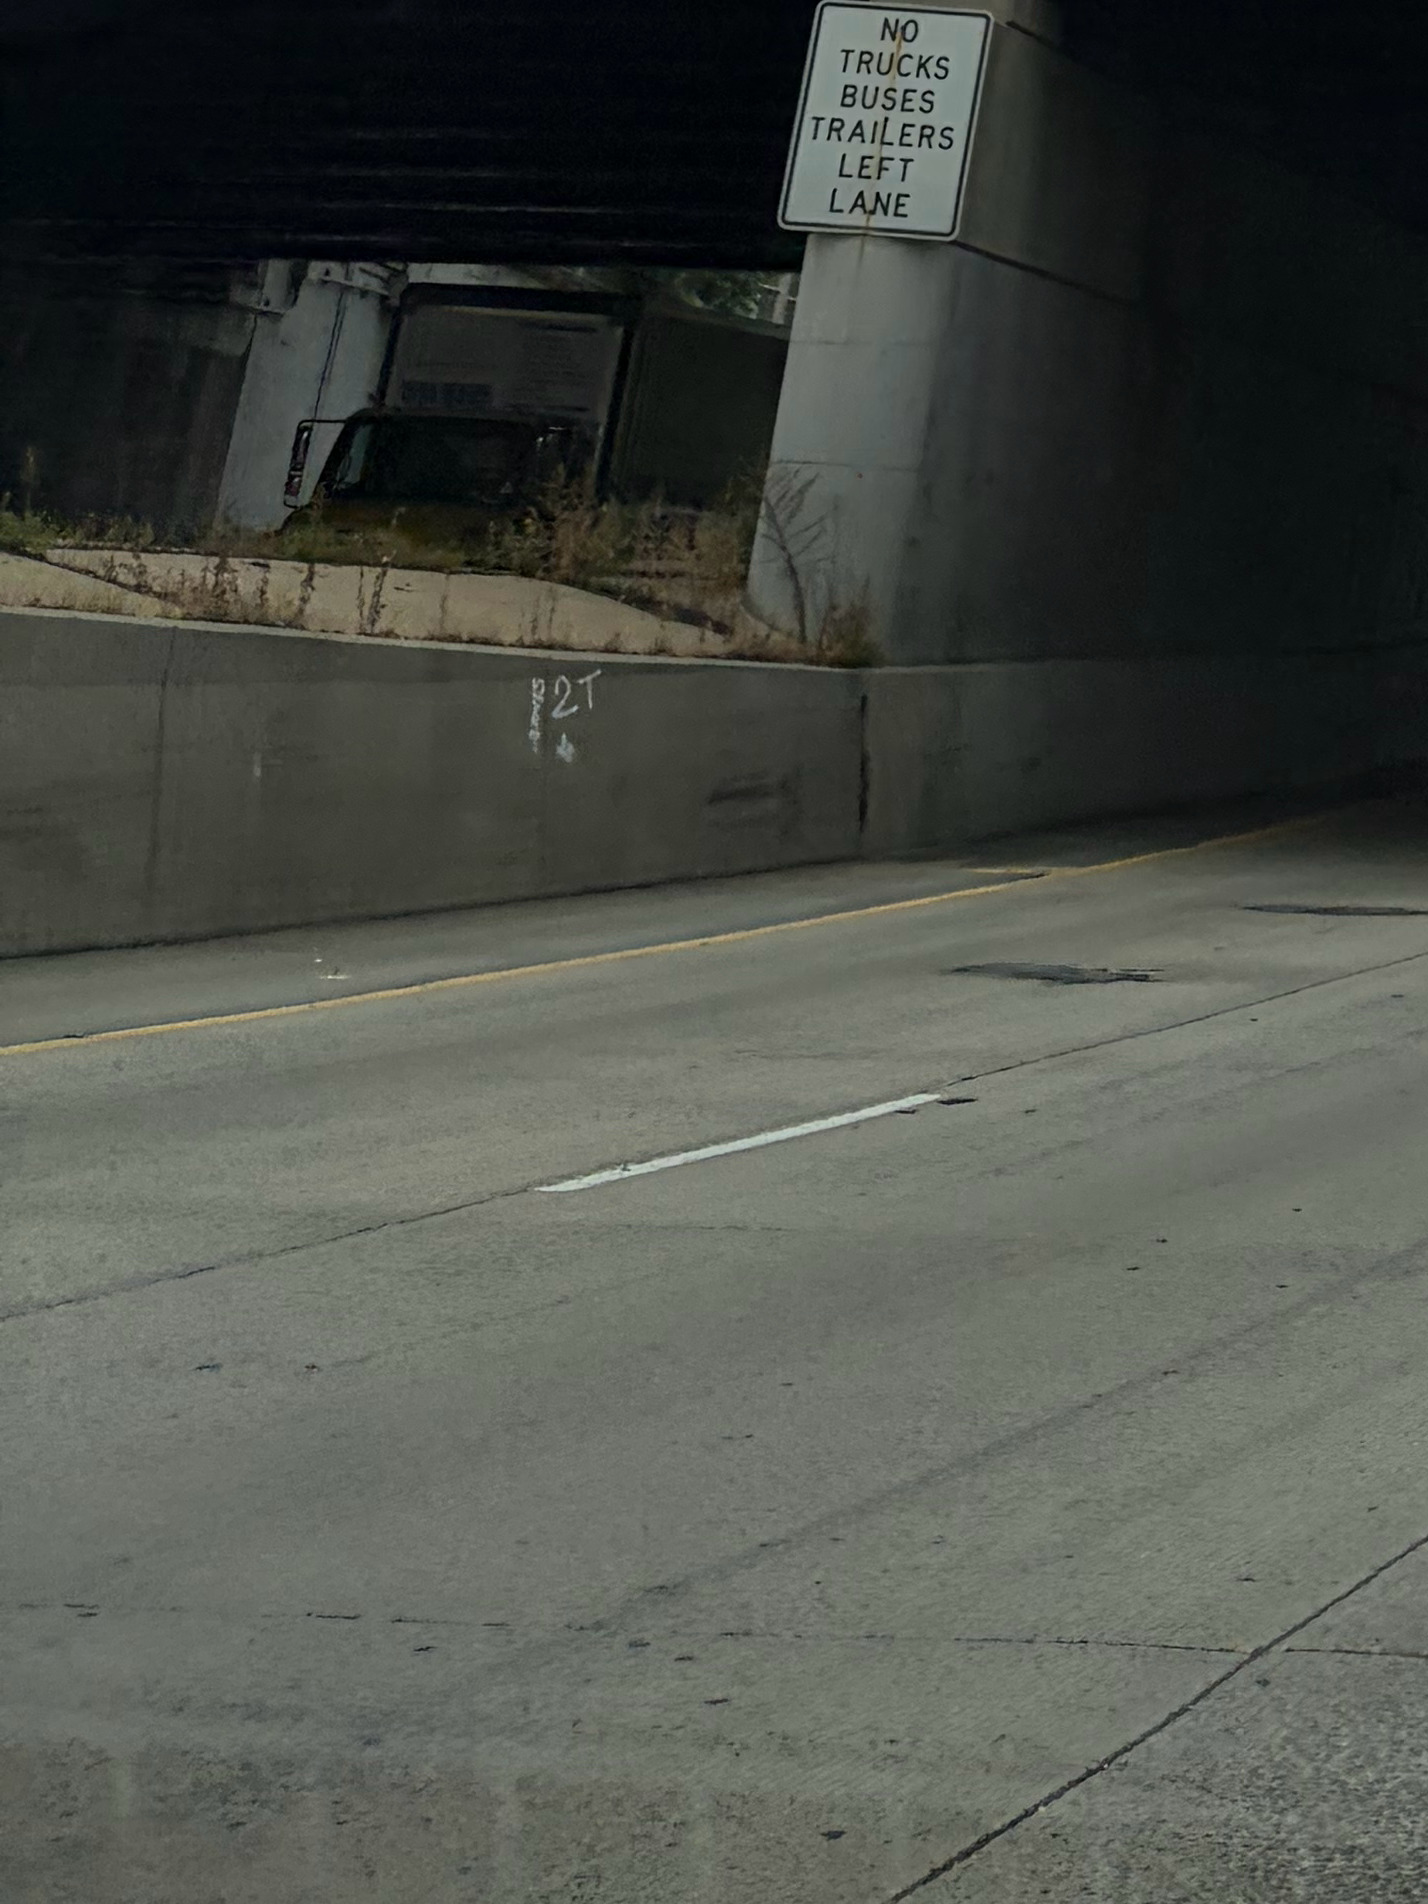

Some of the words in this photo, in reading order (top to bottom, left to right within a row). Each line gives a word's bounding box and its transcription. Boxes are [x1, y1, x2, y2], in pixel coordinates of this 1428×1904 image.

[880, 17, 919, 43] NO
[840, 49, 951, 80] TRUCKS
[840, 84, 936, 114] BUSES
[811, 116, 955, 151] TRAILERS
[838, 153, 915, 183] LEFT
[829, 188, 911, 219] LANE
